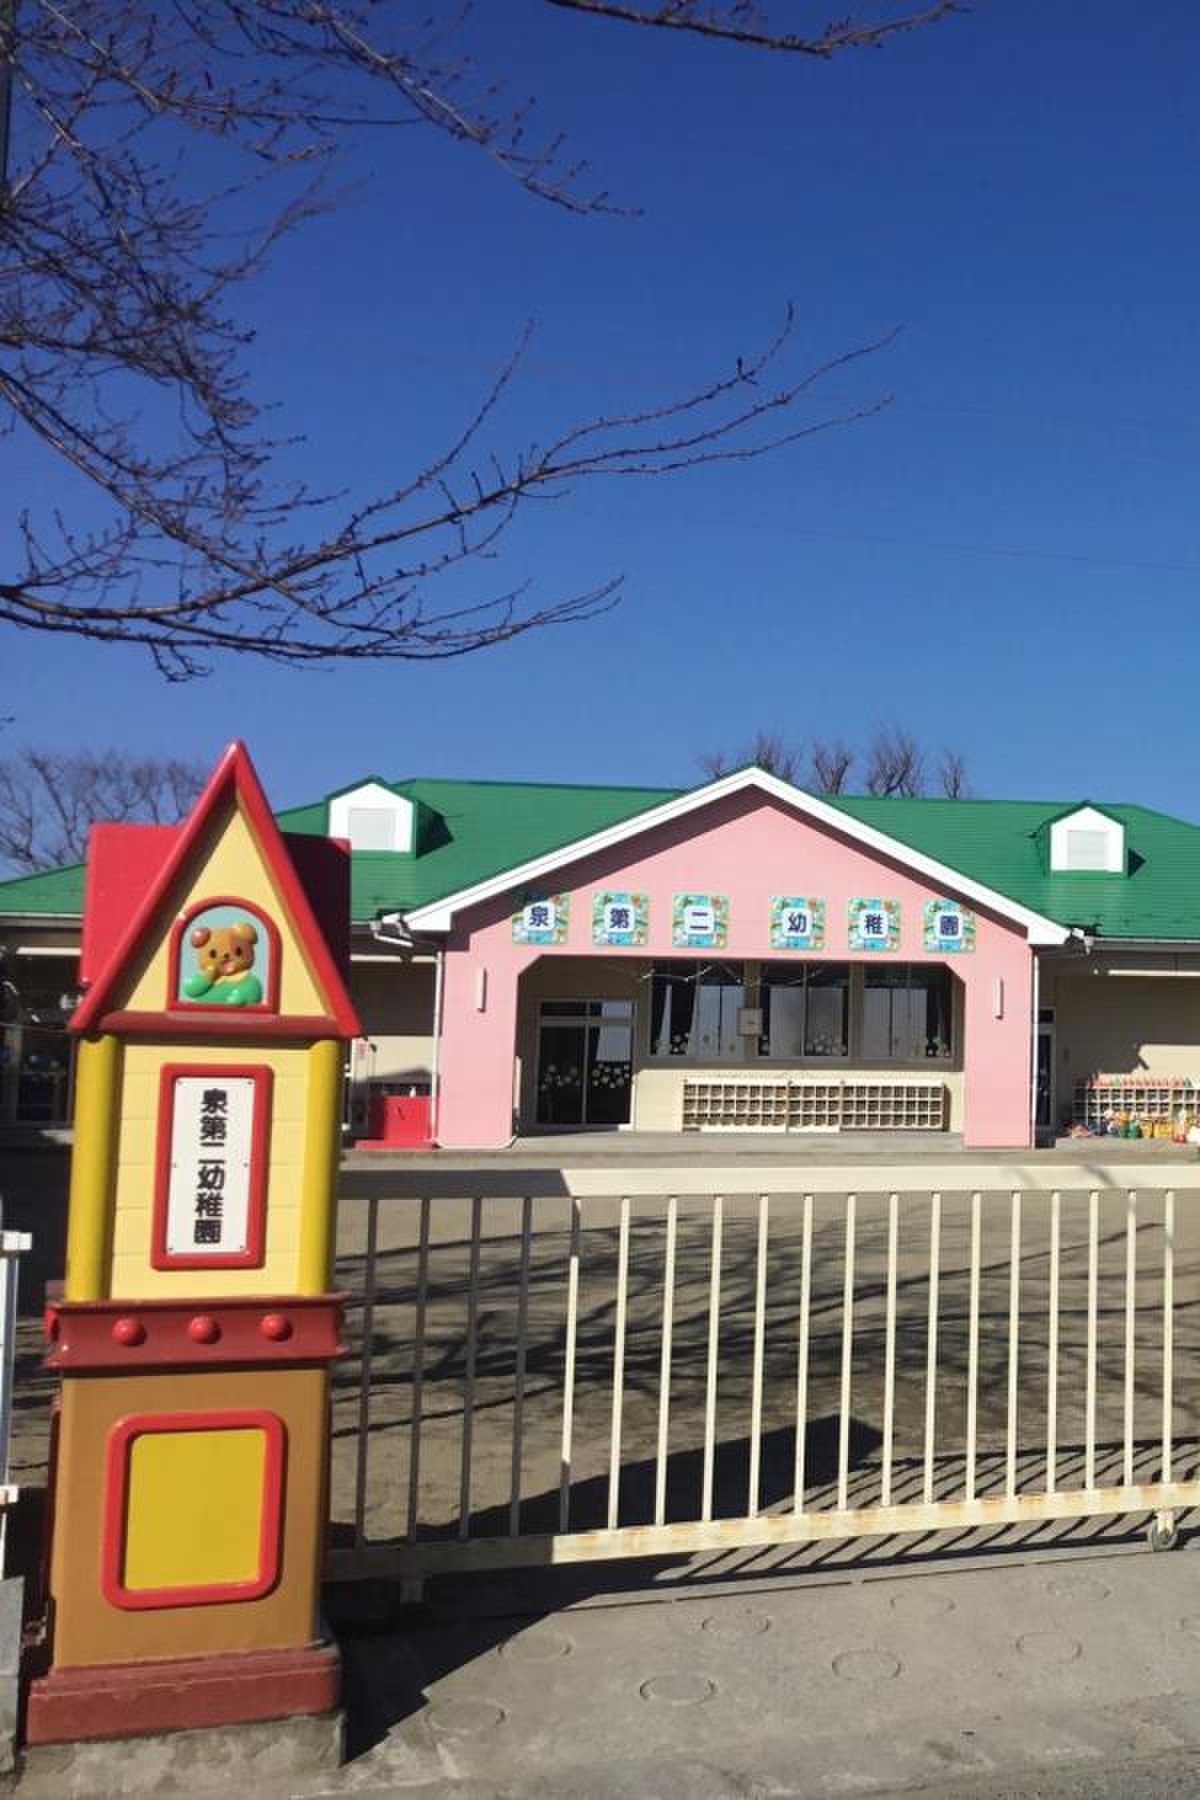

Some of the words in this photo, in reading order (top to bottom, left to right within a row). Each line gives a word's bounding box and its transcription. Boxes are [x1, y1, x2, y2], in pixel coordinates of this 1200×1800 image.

[193, 1088, 228, 1244] 泉第二幼稚園
